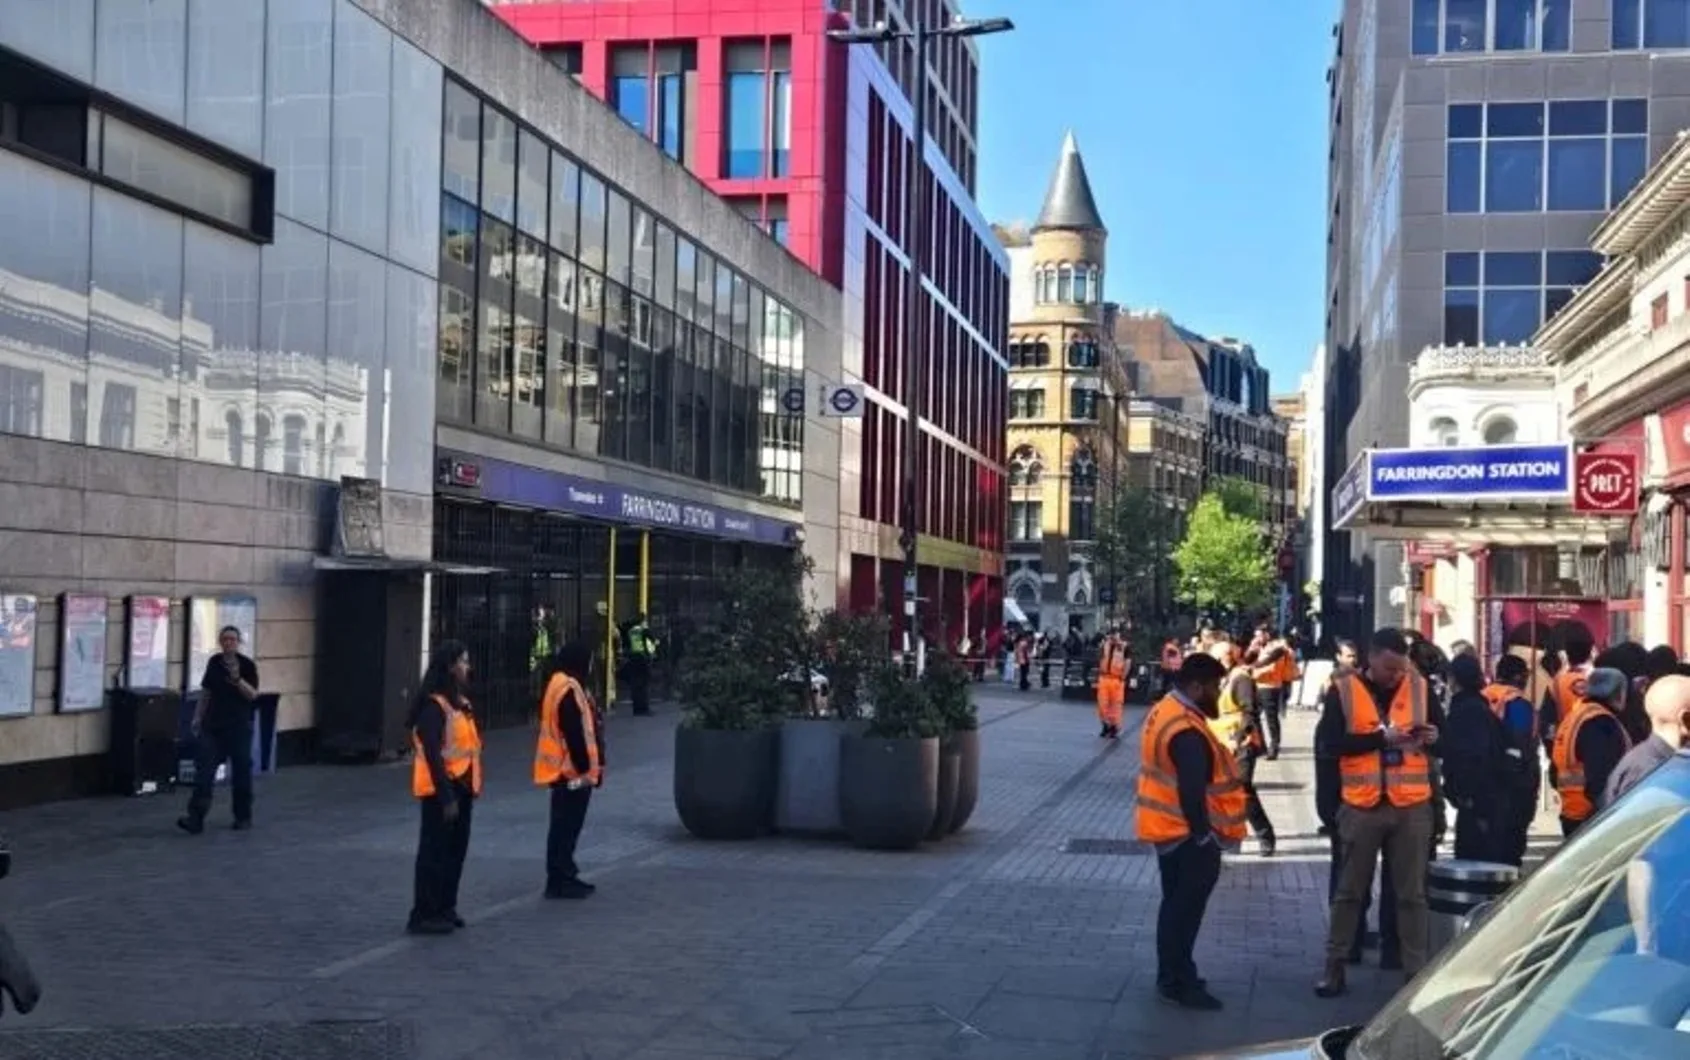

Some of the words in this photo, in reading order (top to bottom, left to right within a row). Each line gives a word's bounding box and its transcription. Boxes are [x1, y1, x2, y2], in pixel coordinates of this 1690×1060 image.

[1377, 464, 1484, 482] FARRINGDON
[1488, 461, 1560, 478] STATION
[1591, 474, 1621, 492] PRET
[621, 493, 680, 524] FARRINGDON
[682, 505, 715, 529] STATION
